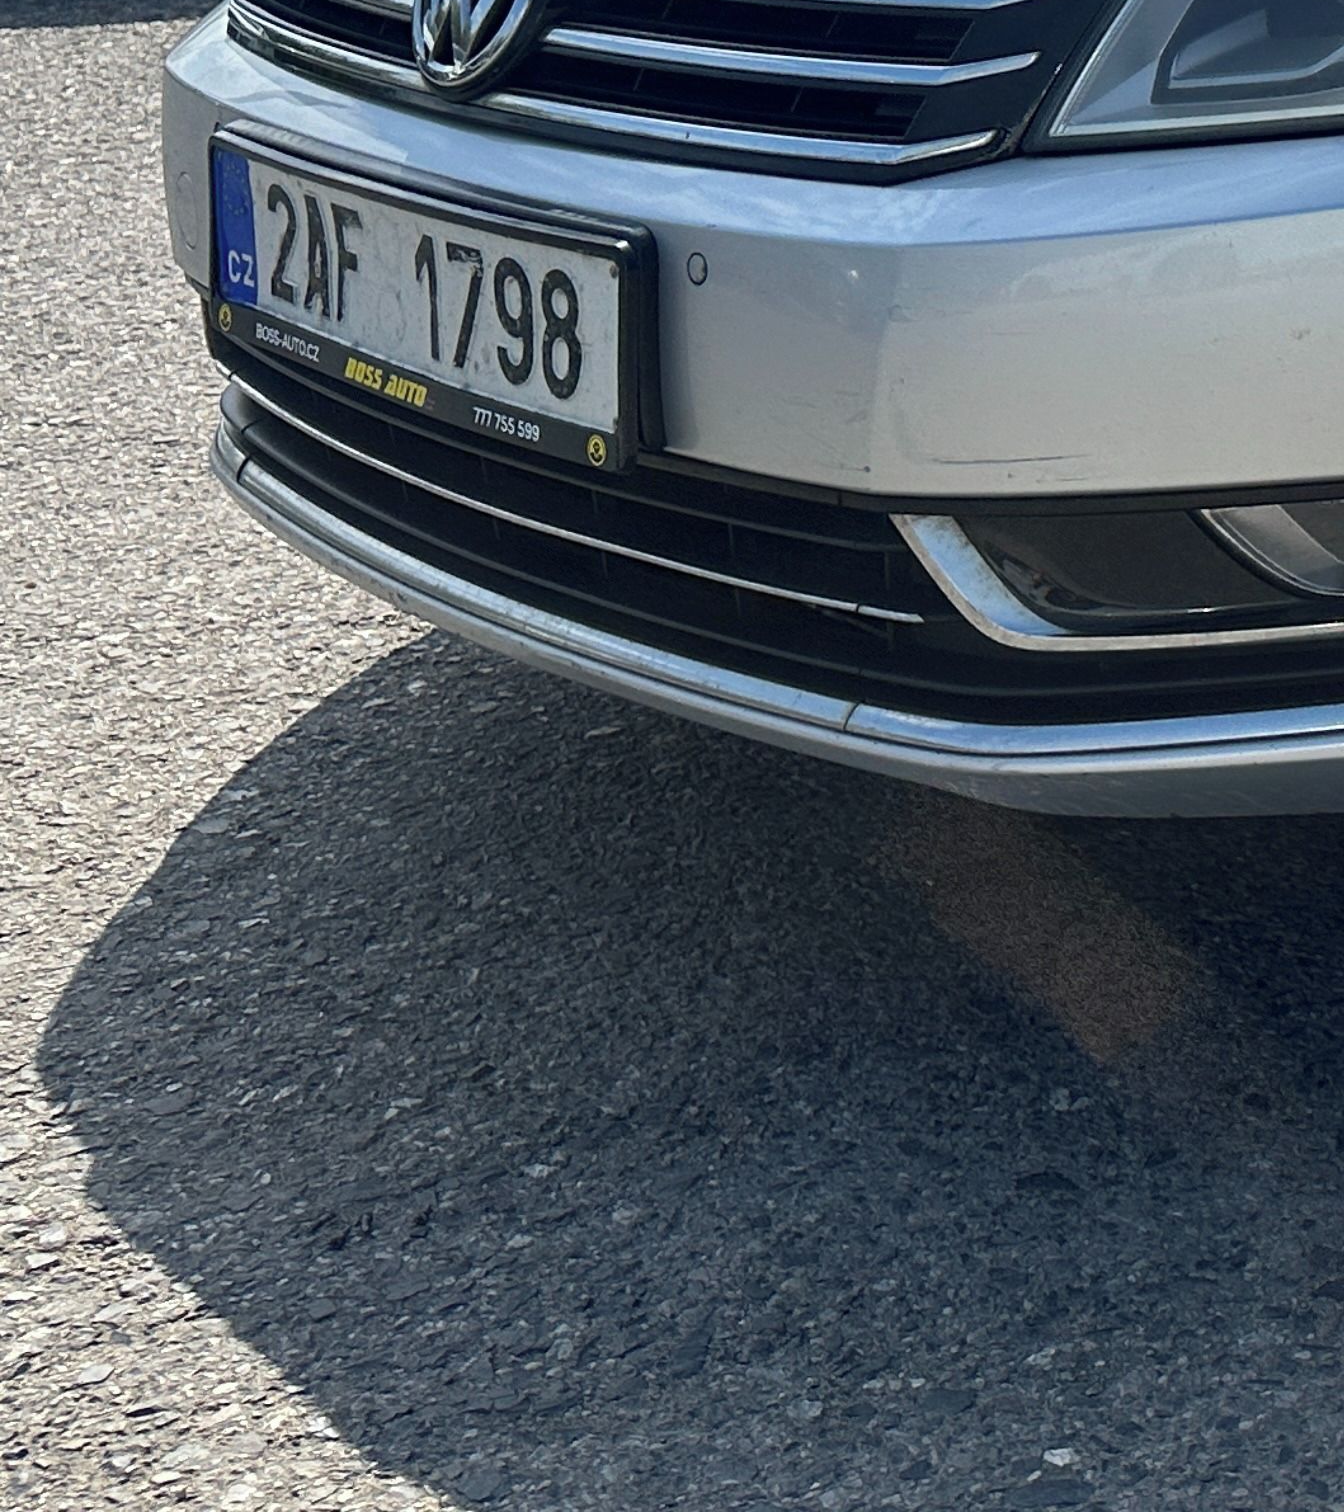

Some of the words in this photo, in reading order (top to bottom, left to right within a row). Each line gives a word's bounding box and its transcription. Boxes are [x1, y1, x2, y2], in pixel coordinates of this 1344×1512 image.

[228, 250, 256, 289] CZ
[267, 183, 364, 323] 2AF
[414, 233, 583, 401] 1798
[255, 322, 320, 363] BOSS-AUTO.CZ
[343, 356, 383, 391] BOSS
[472, 406, 492, 428] 777
[493, 412, 515, 435] 755
[517, 420, 541, 442] 599
